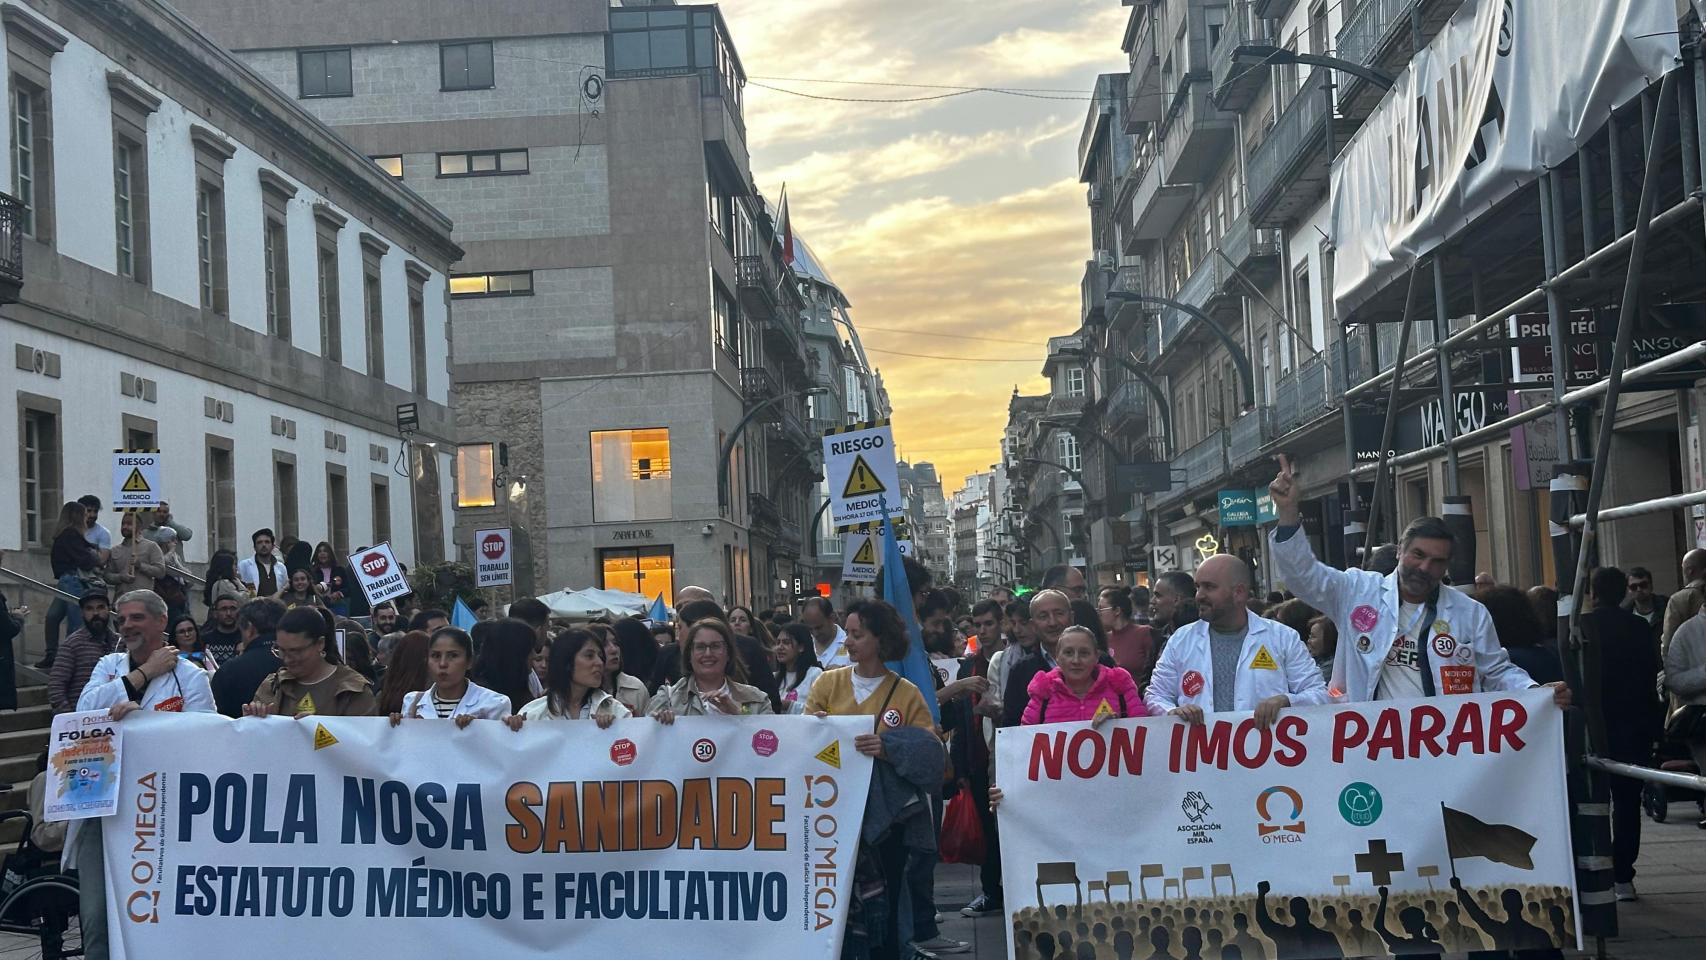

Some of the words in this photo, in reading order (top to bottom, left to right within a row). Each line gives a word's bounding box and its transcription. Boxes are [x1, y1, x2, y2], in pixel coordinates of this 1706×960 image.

[831, 435, 884, 456] RIESGO
[1357, 449, 1395, 459] MANO
[118, 457, 154, 466] RIESGO
[842, 511, 858, 521] HORA
[483, 542, 504, 552] STOP
[363, 558, 386, 573] STOP
[479, 562, 509, 572] TRABALLO
[366, 574, 400, 592] TRABALLO
[480, 574, 493, 582] SEN
[372, 589, 384, 600] SEN
[1437, 640, 1453, 650] 30
[885, 711, 899, 725] 30
[59, 727, 115, 741] FOLGA
[1028, 726, 1148, 782] NON
[1168, 715, 1309, 773] IMOS
[1332, 699, 1528, 764] PARAR
[614, 742, 631, 751] STOP
[697, 744, 712, 755] 30
[178, 772, 318, 844] POLA
[341, 775, 487, 851] NOSA
[504, 776, 787, 854] SANIDADE
[1177, 823, 1222, 833] ASOCIACIÓN
[1187, 836, 1214, 845] ESPAÑA
[804, 853, 810, 861] de
[175, 865, 355, 918] ESTATUTO
[366, 856, 511, 920] MÉDICO
[523, 873, 544, 920] E
[555, 870, 788, 922] FACULTATIVO
